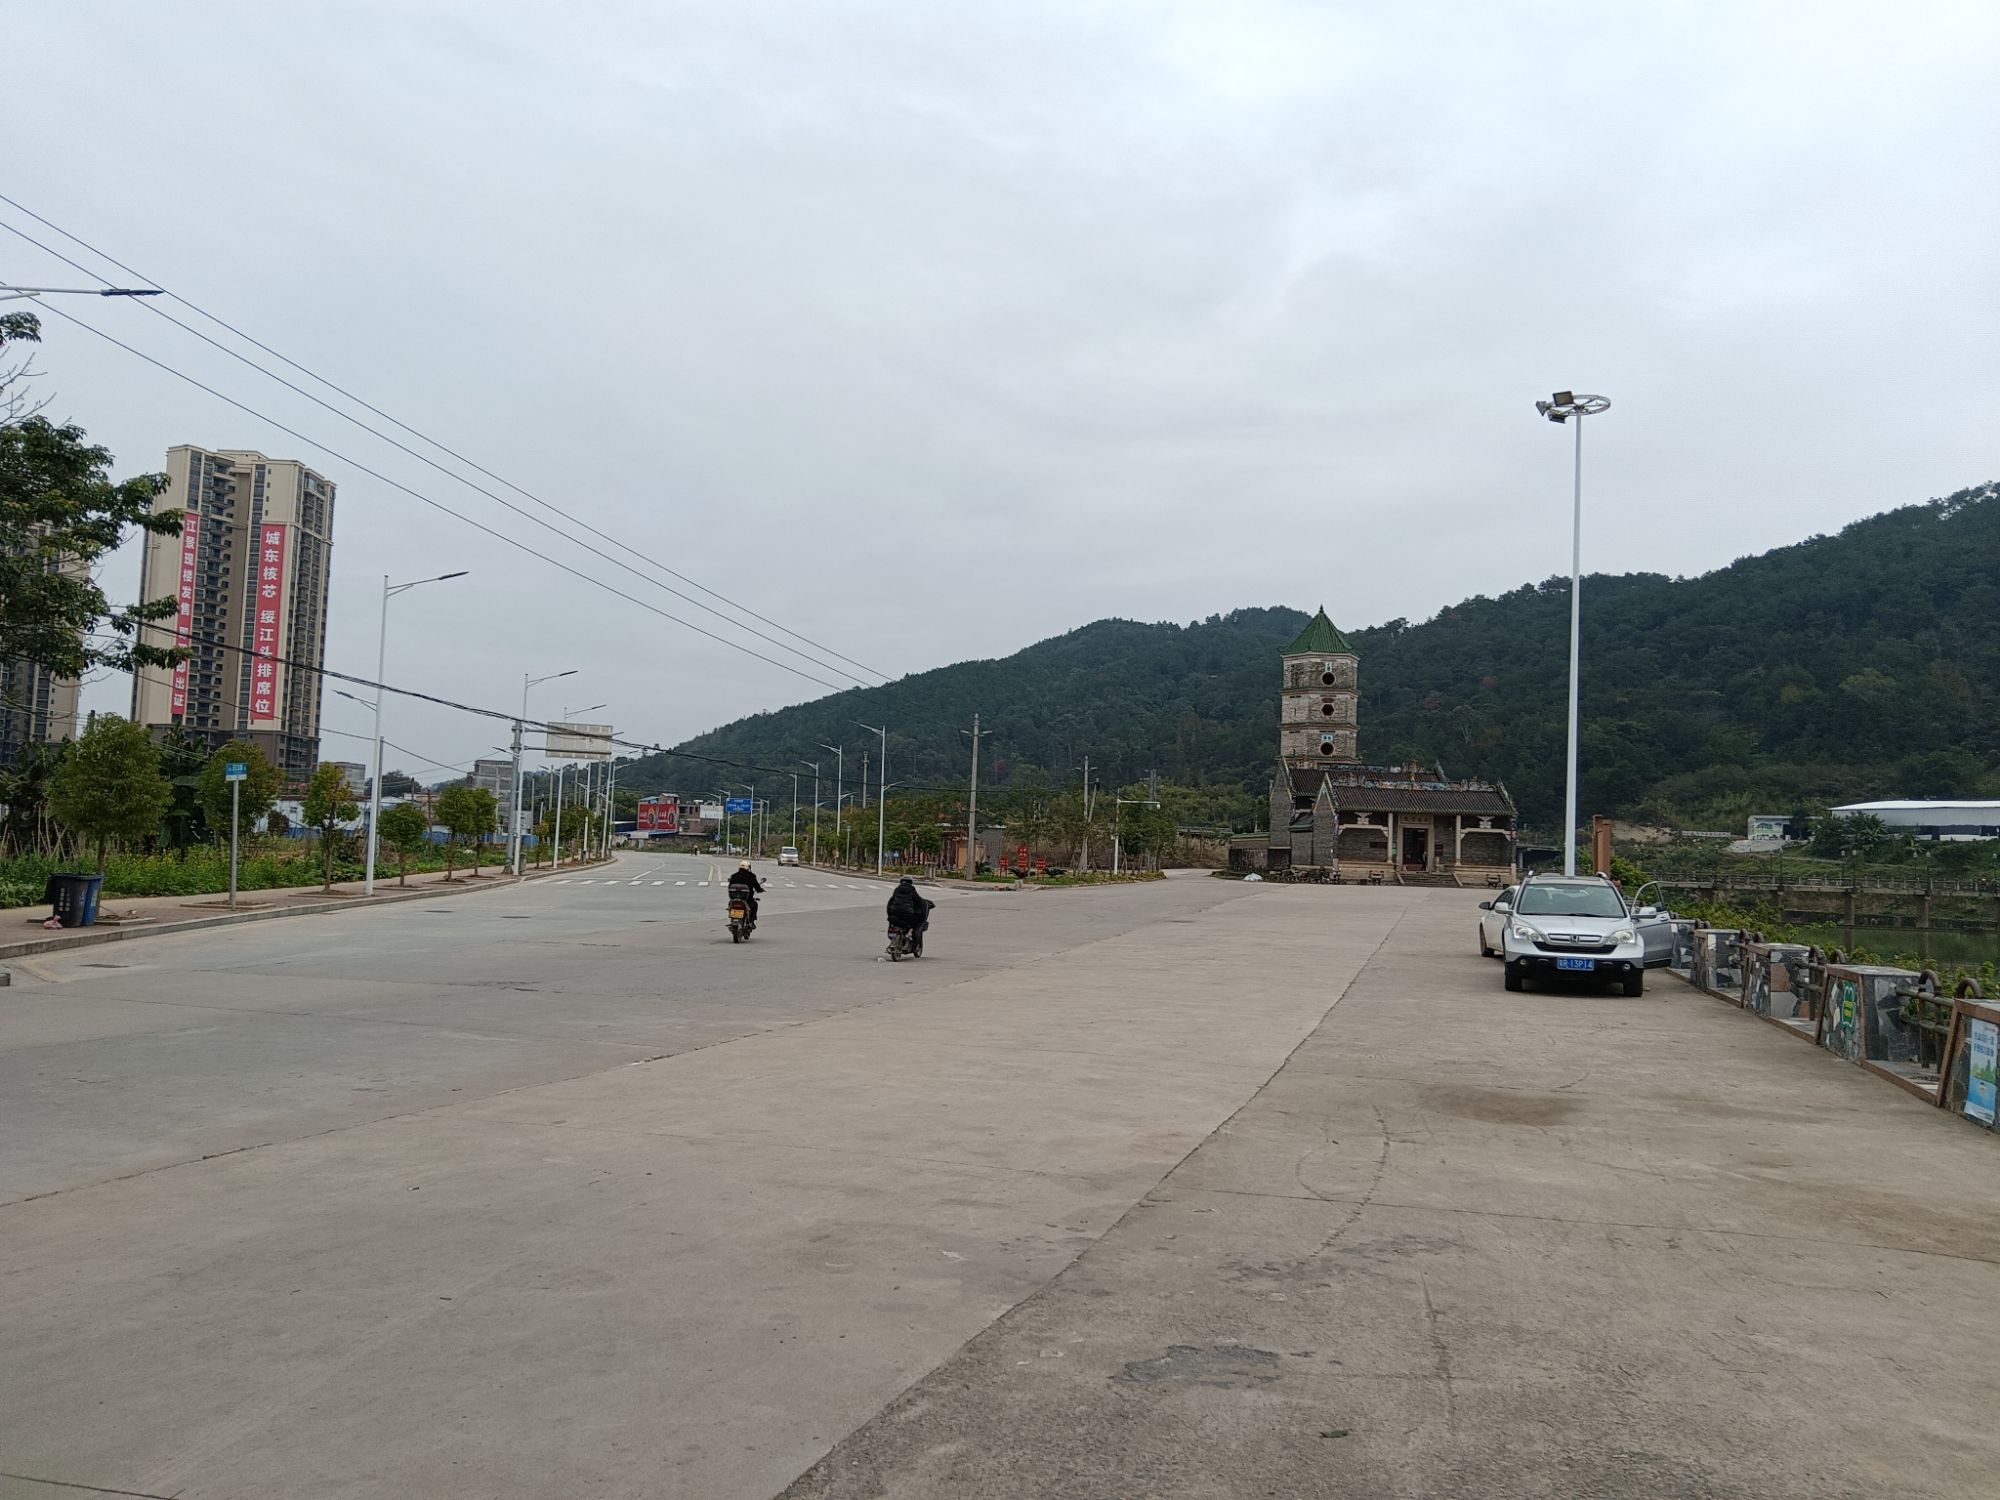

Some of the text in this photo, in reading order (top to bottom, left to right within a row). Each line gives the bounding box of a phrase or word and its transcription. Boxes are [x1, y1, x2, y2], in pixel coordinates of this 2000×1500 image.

[255, 531, 280, 713] 城东核芯 绥江头排席位
